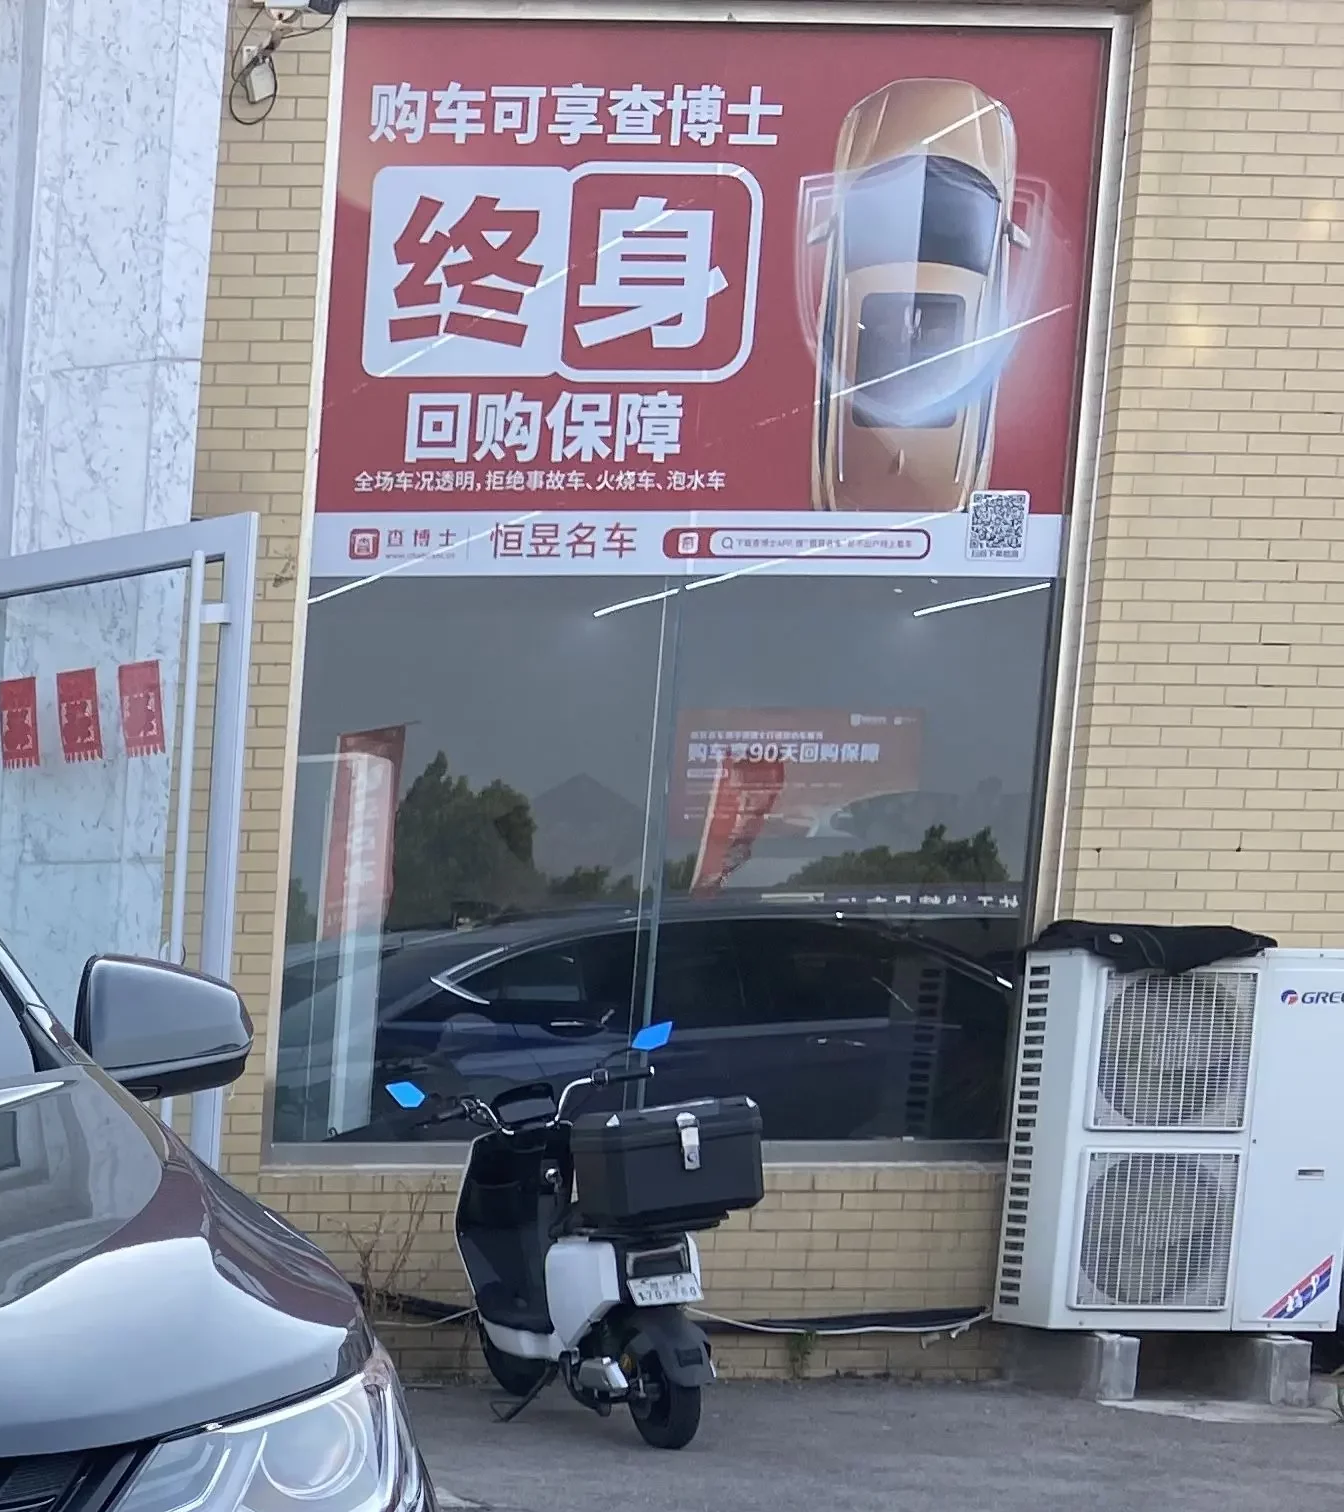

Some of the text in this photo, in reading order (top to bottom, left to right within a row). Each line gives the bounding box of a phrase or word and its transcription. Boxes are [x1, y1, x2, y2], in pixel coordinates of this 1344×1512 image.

[369, 82, 783, 147] 购车可享查博士
[388, 195, 729, 350] 终身
[404, 391, 683, 464] 回购保障
[386, 528, 456, 548] 查博士
[489, 521, 638, 560] 恒昱名车
[1301, 991, 1344, 1004] GRE
